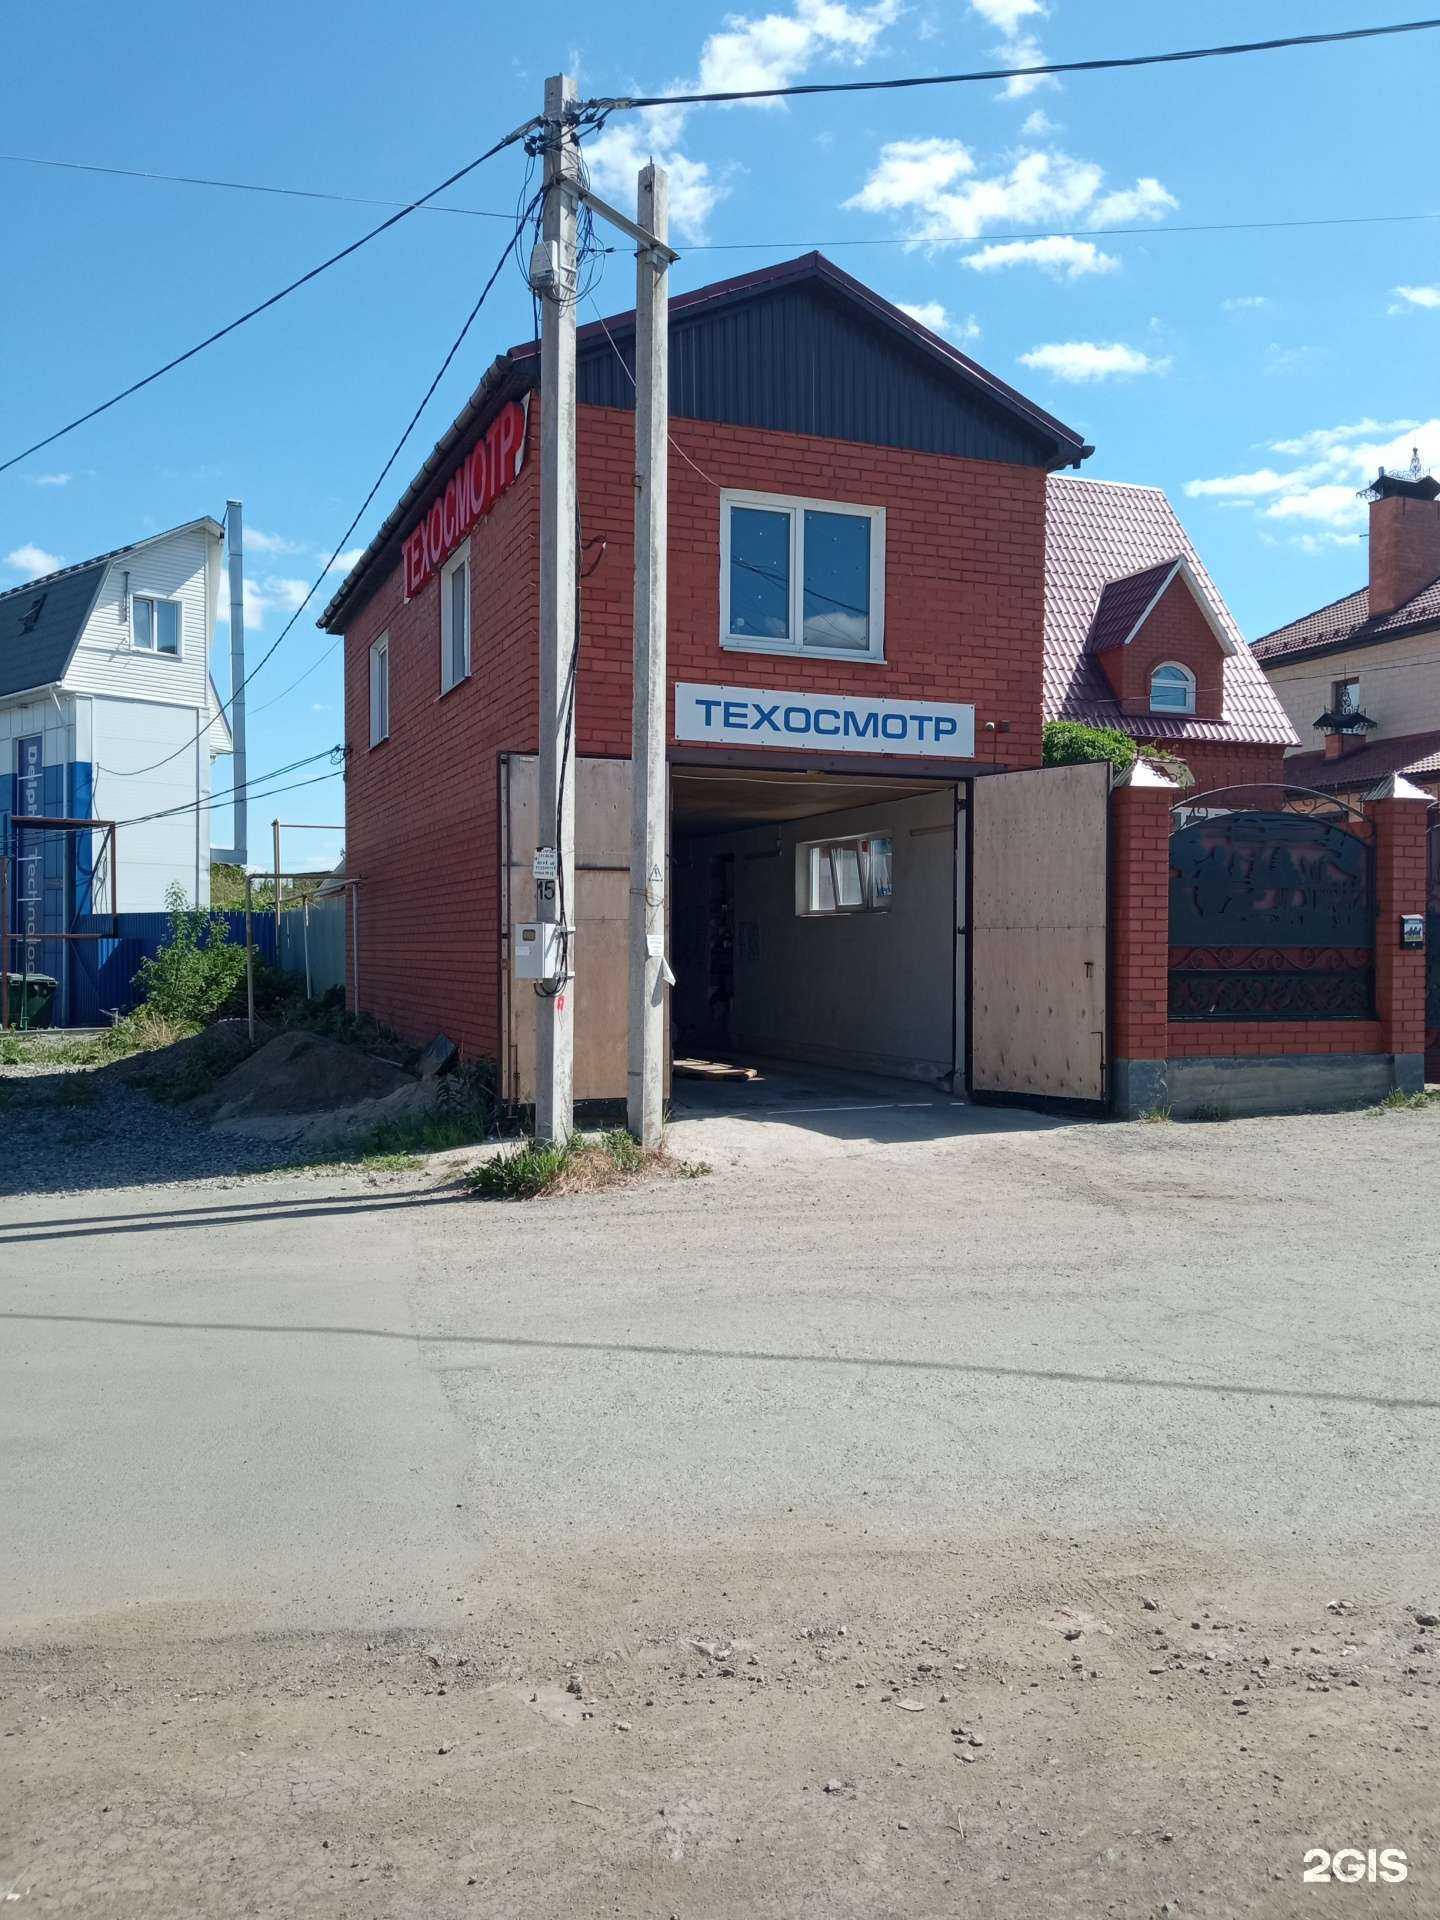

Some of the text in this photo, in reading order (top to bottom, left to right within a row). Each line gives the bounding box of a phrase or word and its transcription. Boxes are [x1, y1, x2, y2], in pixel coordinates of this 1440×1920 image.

[401, 400, 526, 598] ТЕХОСМОТР
[694, 699, 957, 742] ТЕХОСМОТР
[25, 746, 38, 975] Delph Technolog
[537, 880, 556, 900] 15
